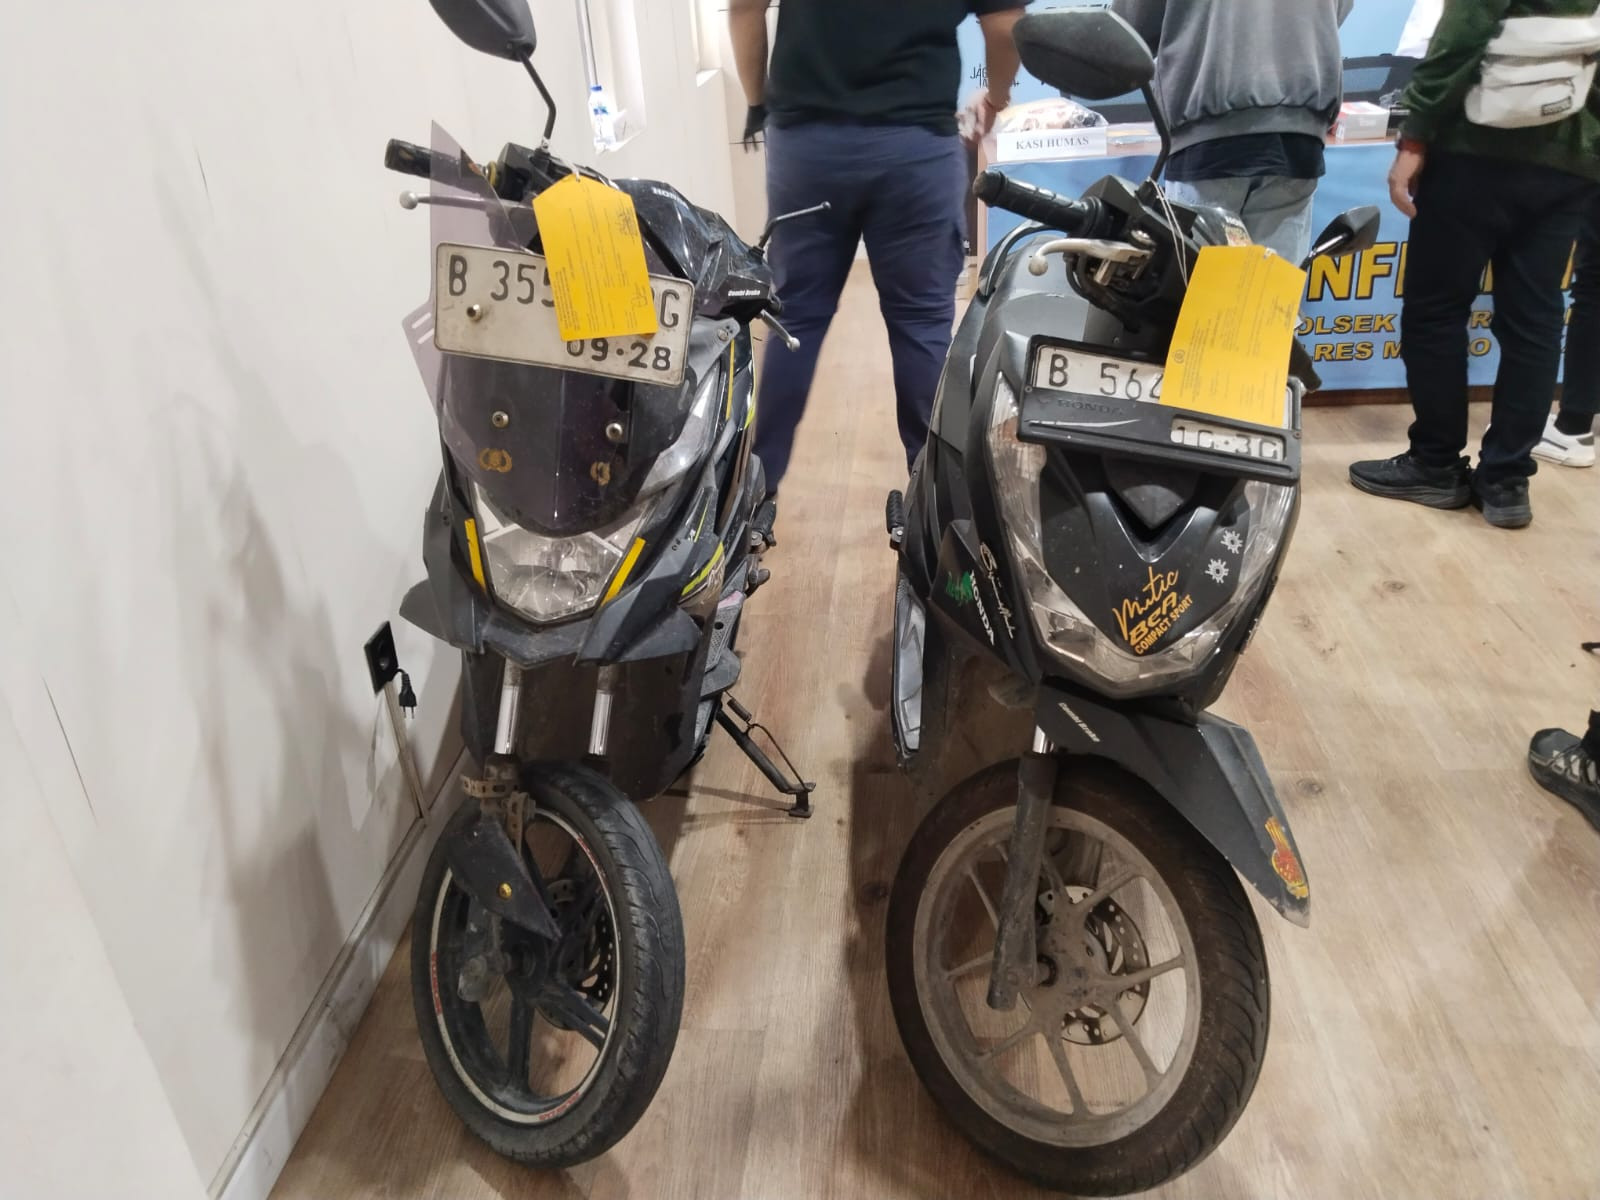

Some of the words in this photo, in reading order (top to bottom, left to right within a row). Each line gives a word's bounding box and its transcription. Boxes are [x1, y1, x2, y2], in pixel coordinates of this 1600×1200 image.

[1016, 140, 1043, 150] KASI
[1047, 137, 1089, 148] HUMAS
[449, 254, 468, 296] B
[1297, 313, 1398, 336] OLSEK
[1048, 353, 1069, 387] B
[1134, 617, 1172, 655] COMPACT
[1169, 594, 1193, 622] SPORT
